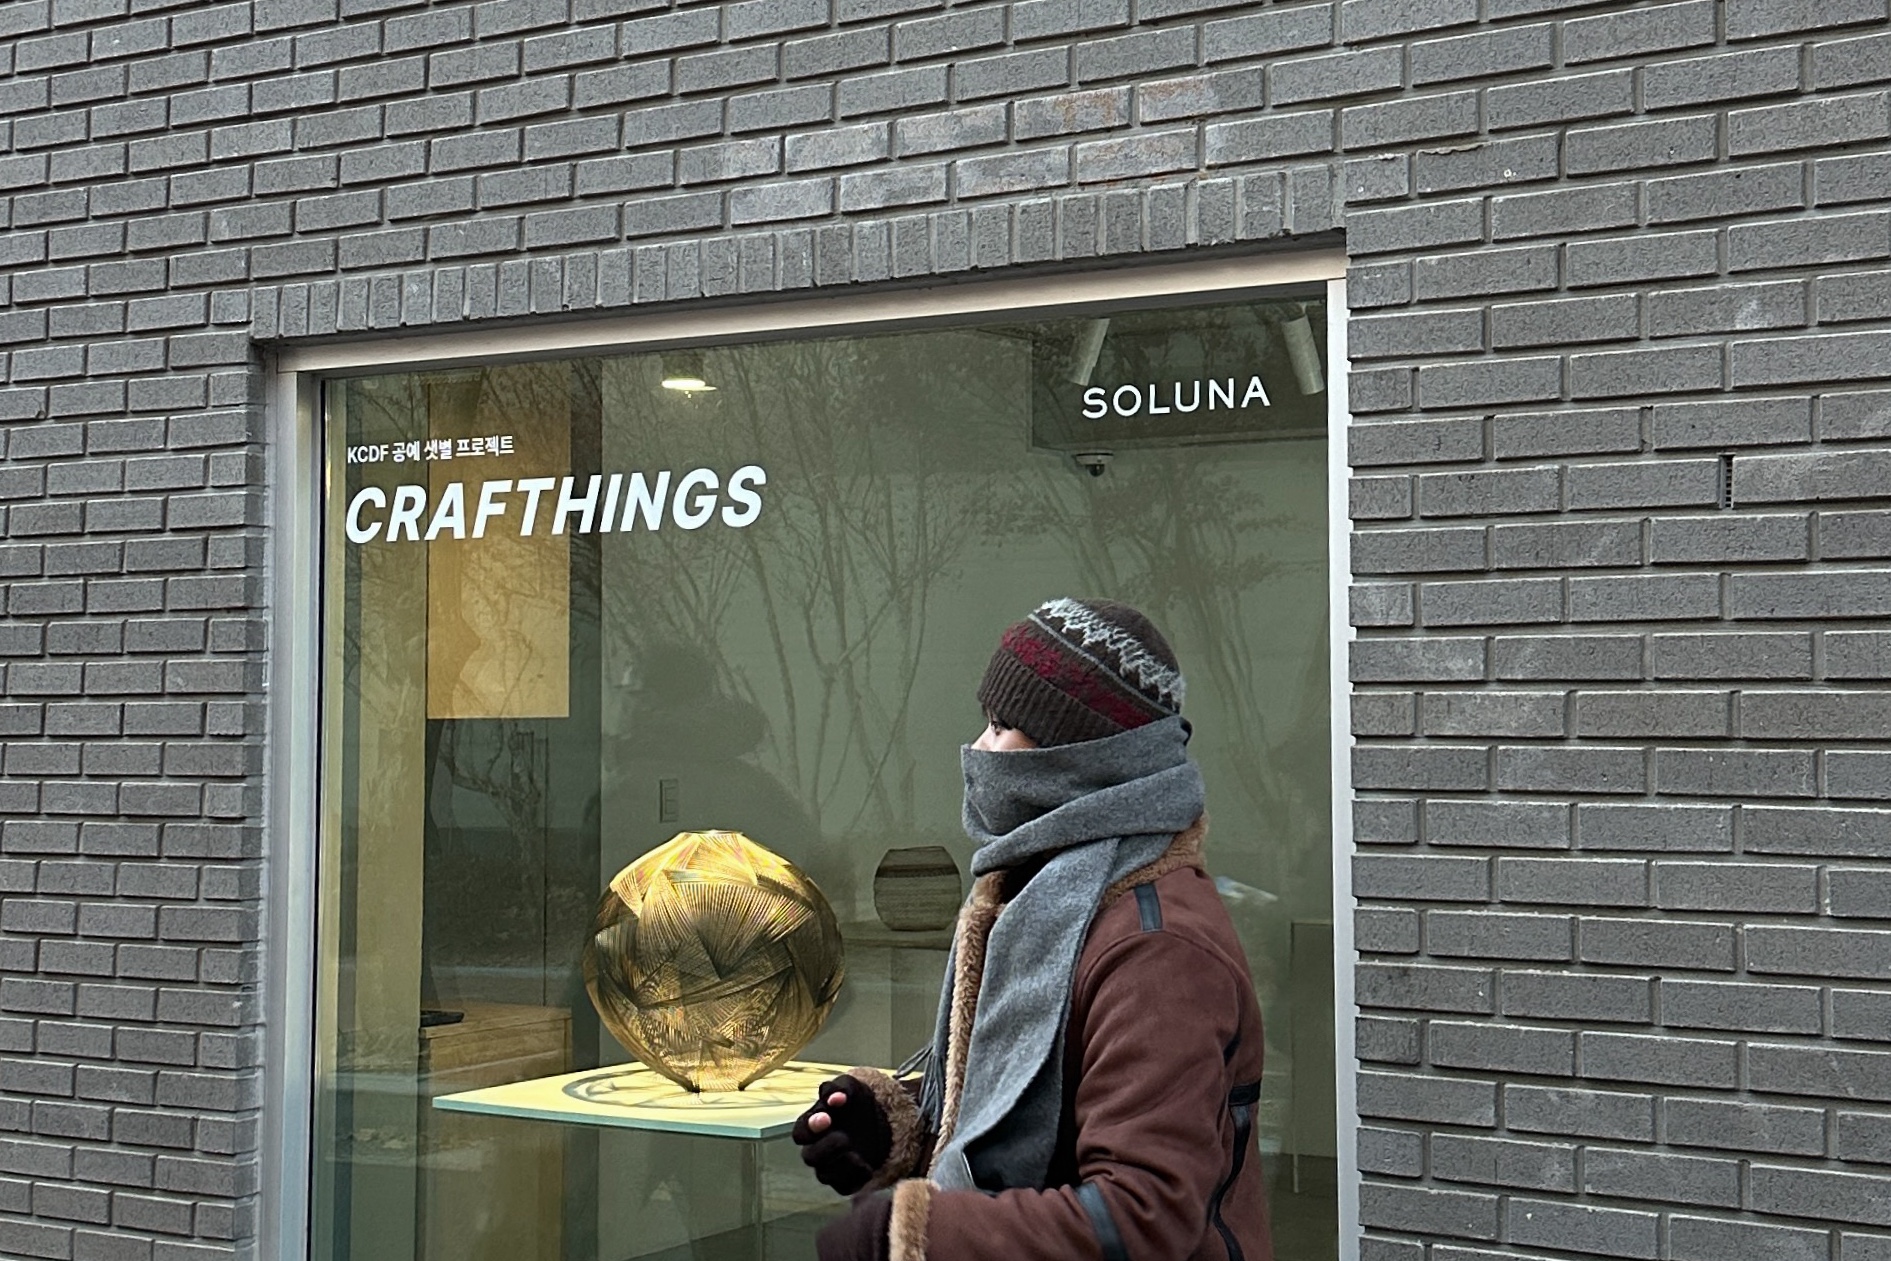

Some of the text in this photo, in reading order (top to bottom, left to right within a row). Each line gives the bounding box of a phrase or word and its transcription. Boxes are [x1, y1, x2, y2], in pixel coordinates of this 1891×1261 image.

[1081, 375, 1271, 419] SOLUNA
[347, 435, 515, 464] KCDF 공예 샛별 프로젝트
[345, 465, 767, 544] CRAFTHINGS
